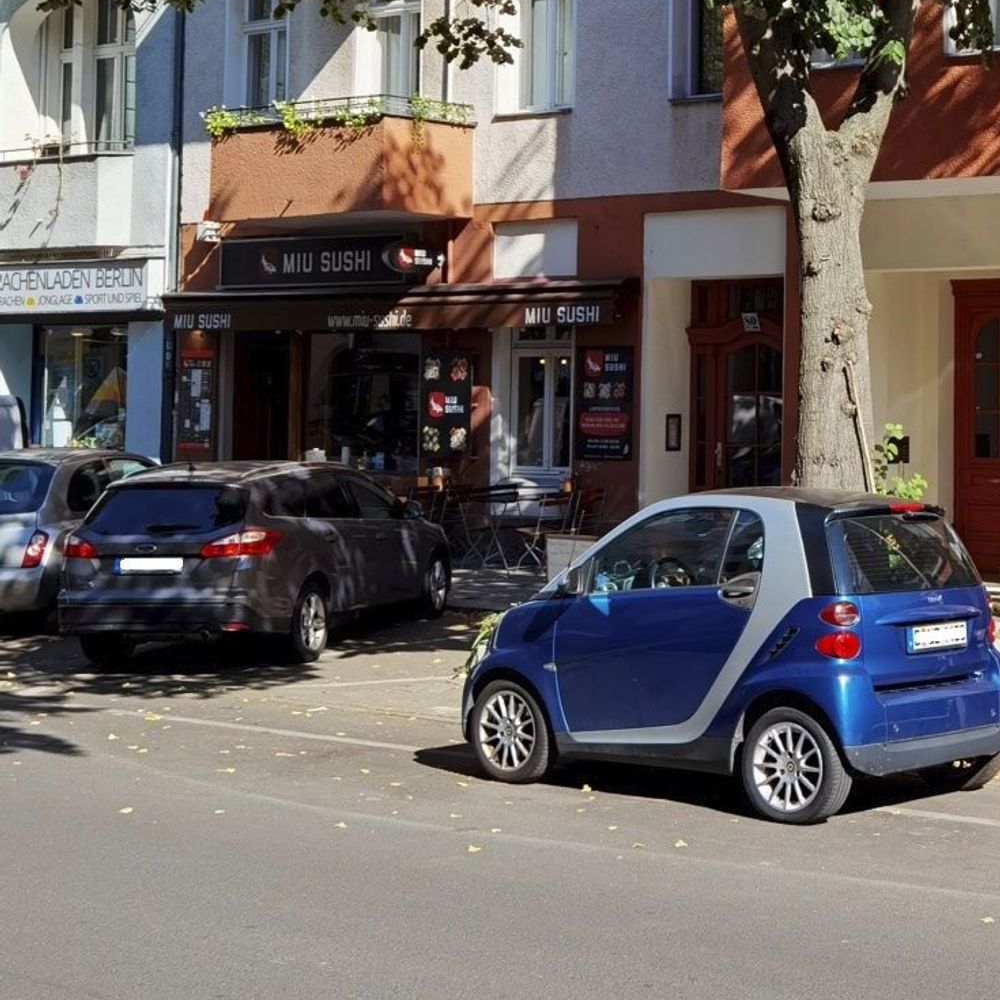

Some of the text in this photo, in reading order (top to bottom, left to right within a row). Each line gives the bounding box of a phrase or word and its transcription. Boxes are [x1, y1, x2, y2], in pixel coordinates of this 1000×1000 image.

[283, 250, 371, 273] MIU SUSHI
[0, 267, 143, 291] ACHENLADEN BERLIN
[174, 313, 231, 329] MIU SUSHI
[327, 309, 412, 328] www.miu-sushi.de
[525, 306, 600, 324] MIU SUSHI
